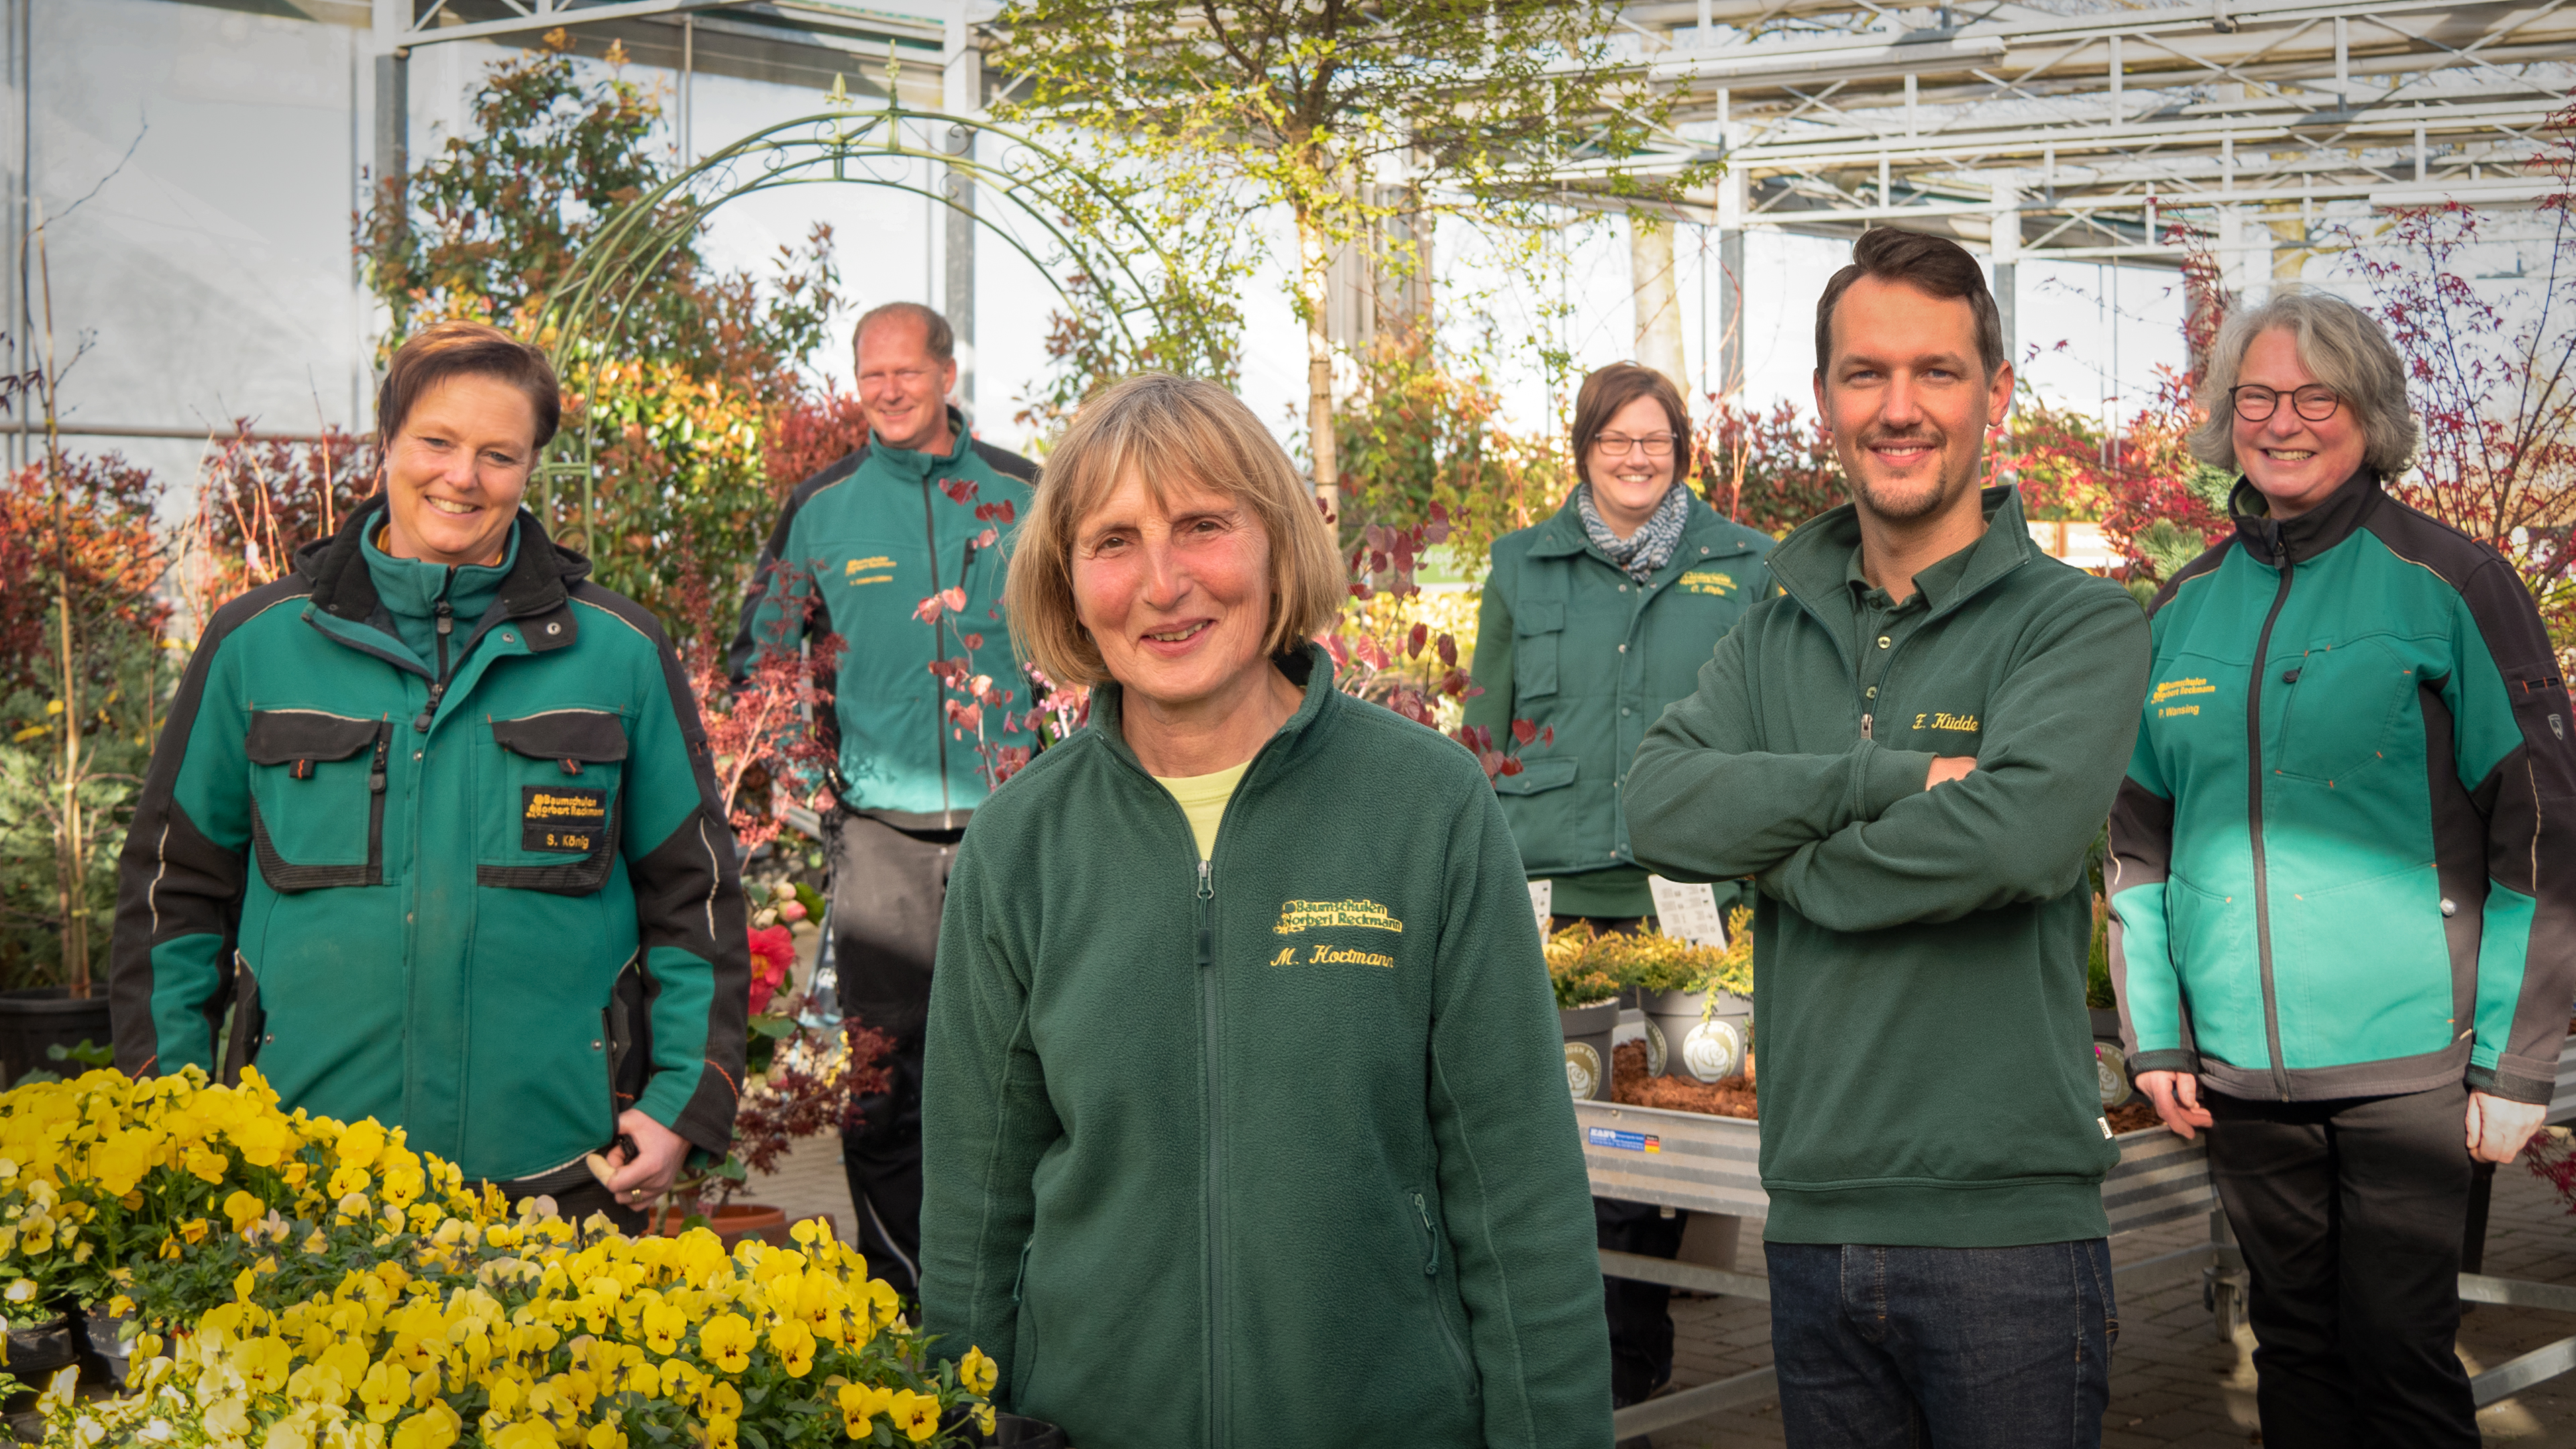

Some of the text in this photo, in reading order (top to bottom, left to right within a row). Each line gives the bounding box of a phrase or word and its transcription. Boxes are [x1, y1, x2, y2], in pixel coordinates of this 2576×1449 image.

[543, 794, 597, 807] Baumschulen
[546, 833, 590, 850] S. König
[1296, 900, 1387, 915] Baumschulen
[1338, 912, 1401, 931] Reckmann
[1270, 945, 1394, 968] M. Kortmann
